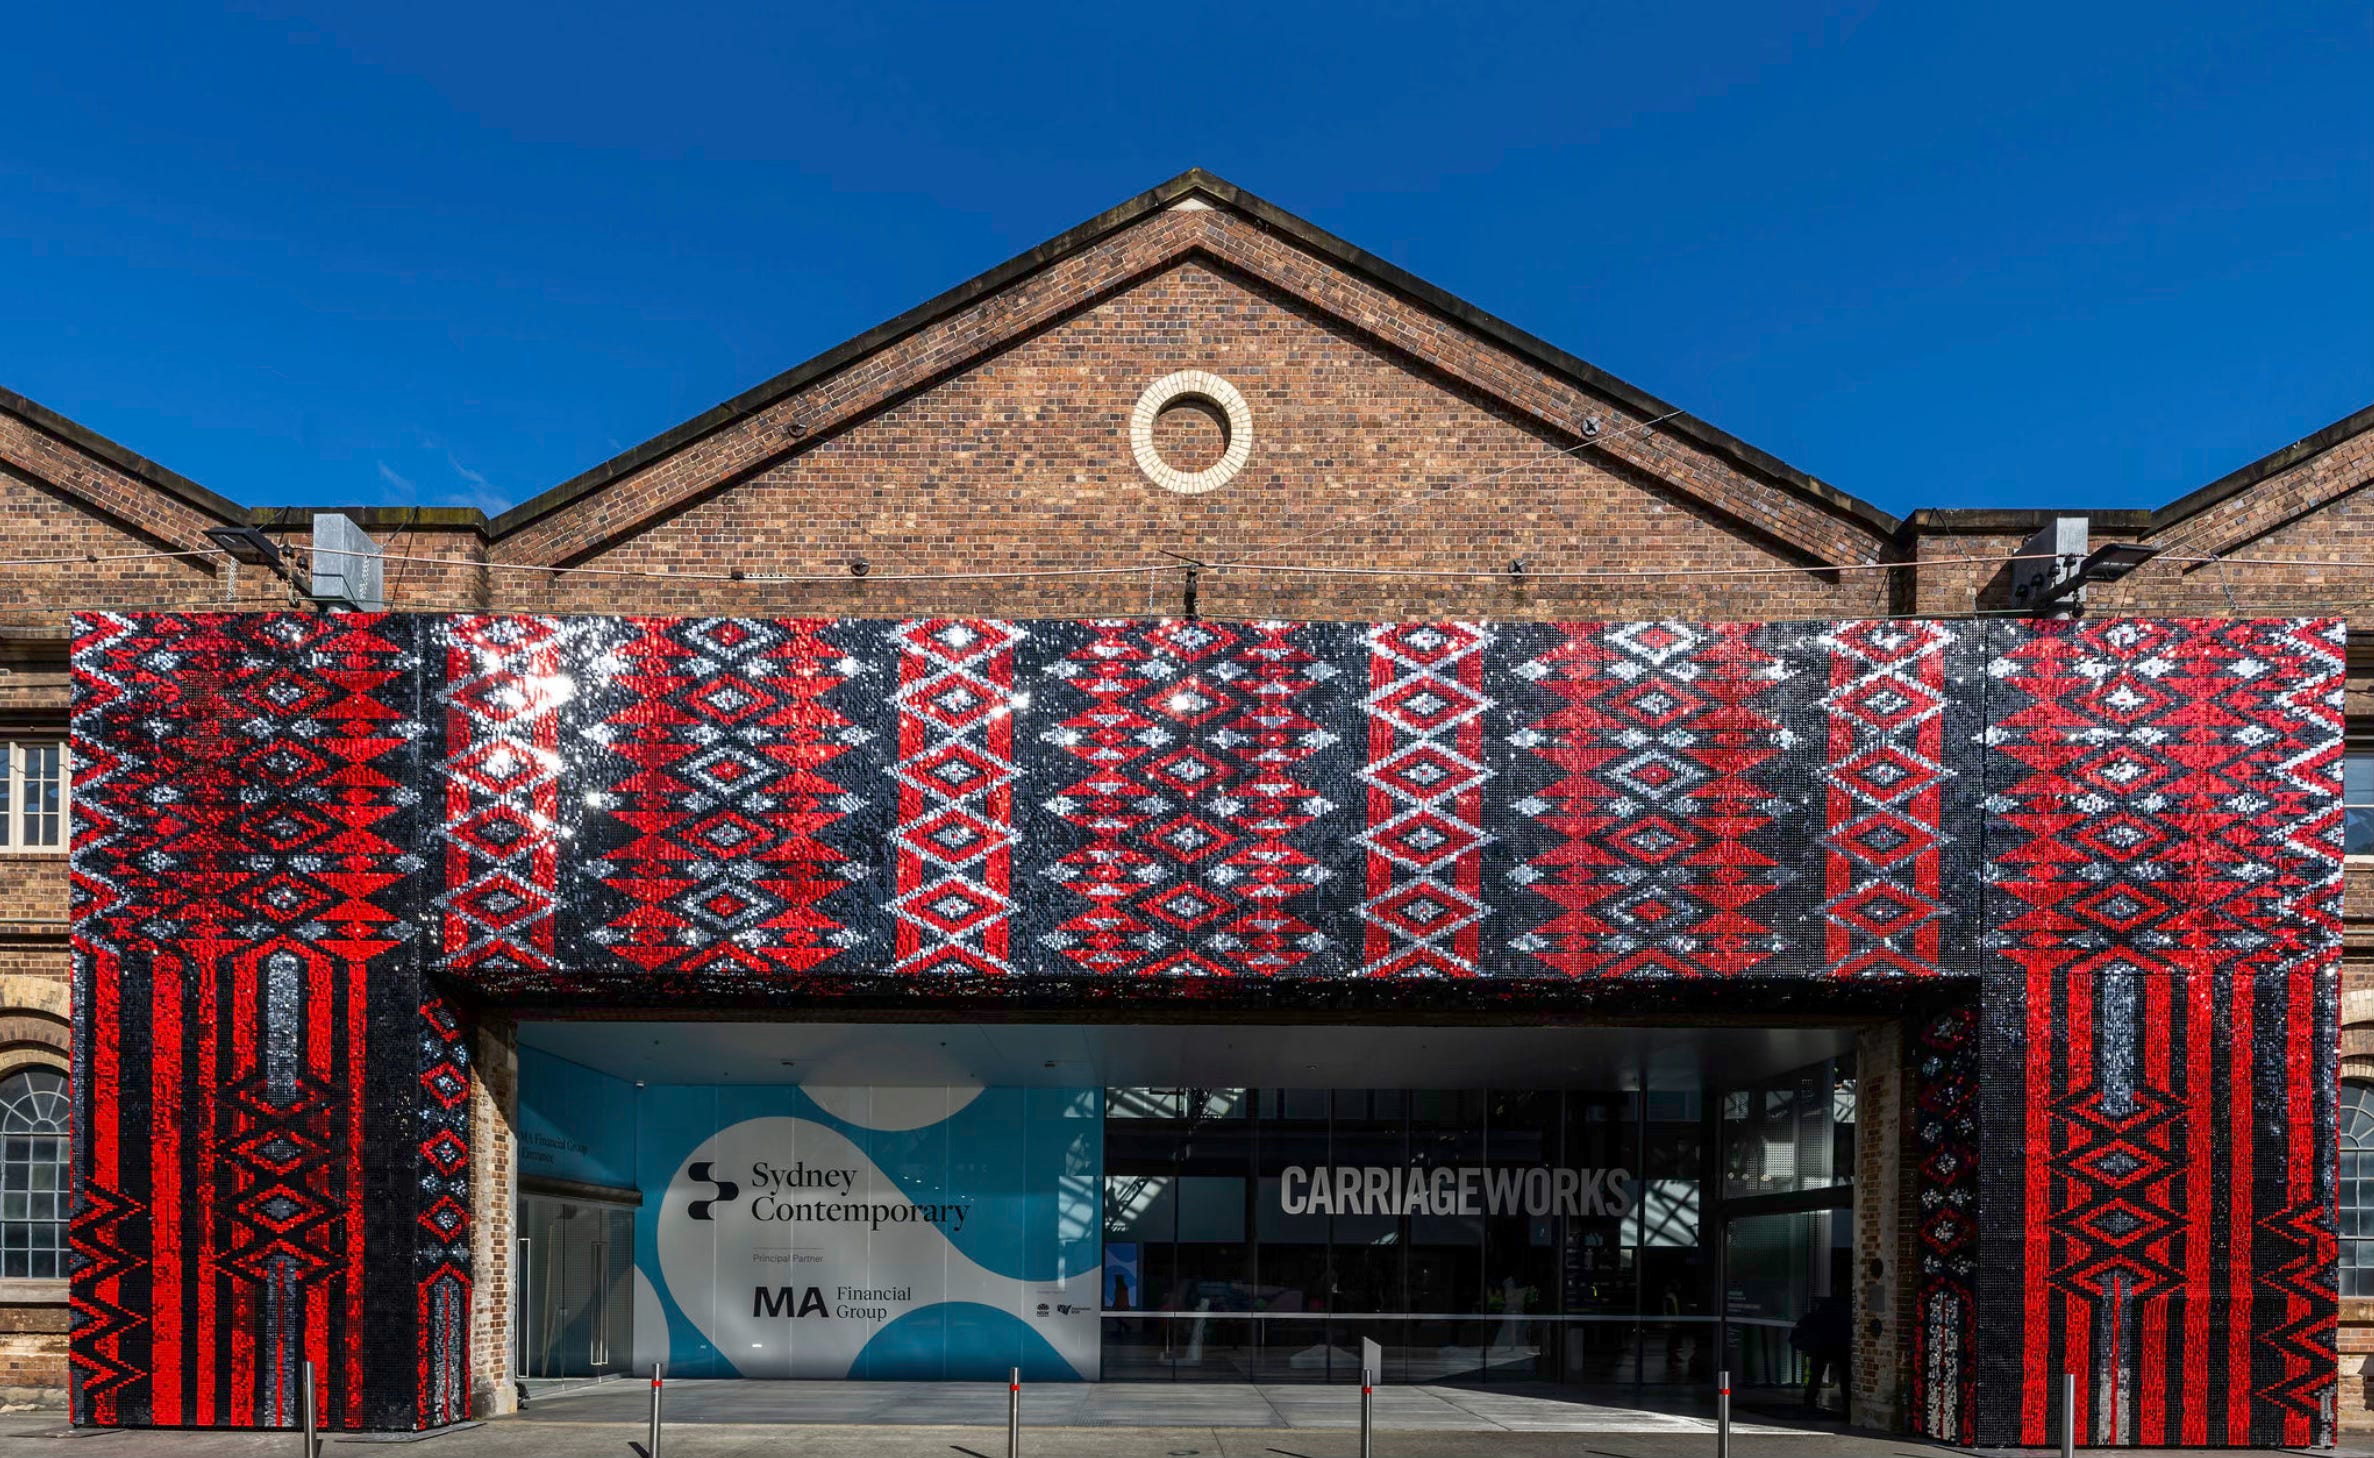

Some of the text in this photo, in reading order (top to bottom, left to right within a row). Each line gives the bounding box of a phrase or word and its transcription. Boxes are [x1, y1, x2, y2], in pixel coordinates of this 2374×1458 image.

[751, 1162, 858, 1196] Sydney
[1280, 1166, 1632, 1217] CARRIAGEWORKS
[751, 1196, 971, 1231] Contemporary
[753, 1254, 824, 1263] Principal Partner
[753, 1286, 829, 1318] MA
[837, 1286, 911, 1301] Financial
[836, 1305, 888, 1321] Group
